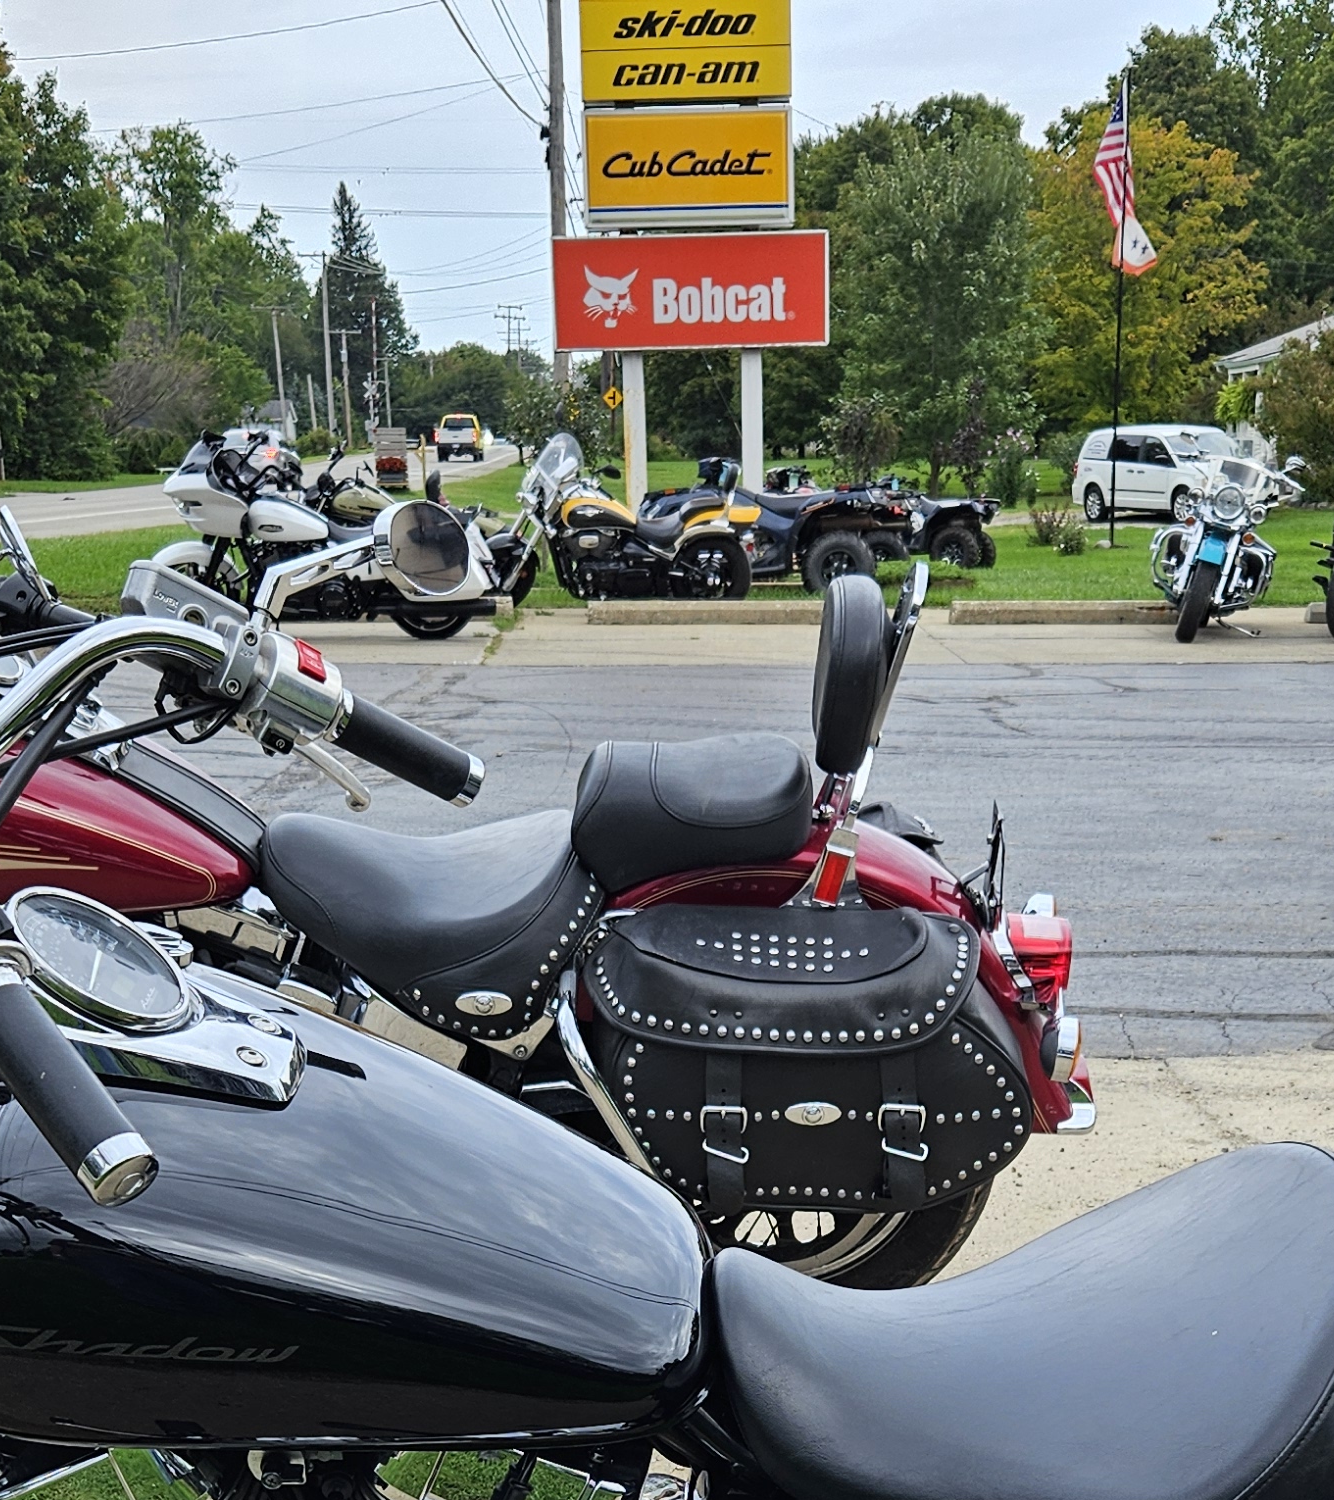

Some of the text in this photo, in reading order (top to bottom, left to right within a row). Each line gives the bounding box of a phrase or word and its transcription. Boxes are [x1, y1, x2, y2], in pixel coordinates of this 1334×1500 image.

[613, 9, 757, 39] ski-doo
[612, 60, 760, 87] can-am
[602, 149, 772, 179] Cub Cadet
[652, 276, 787, 324] Bobcat
